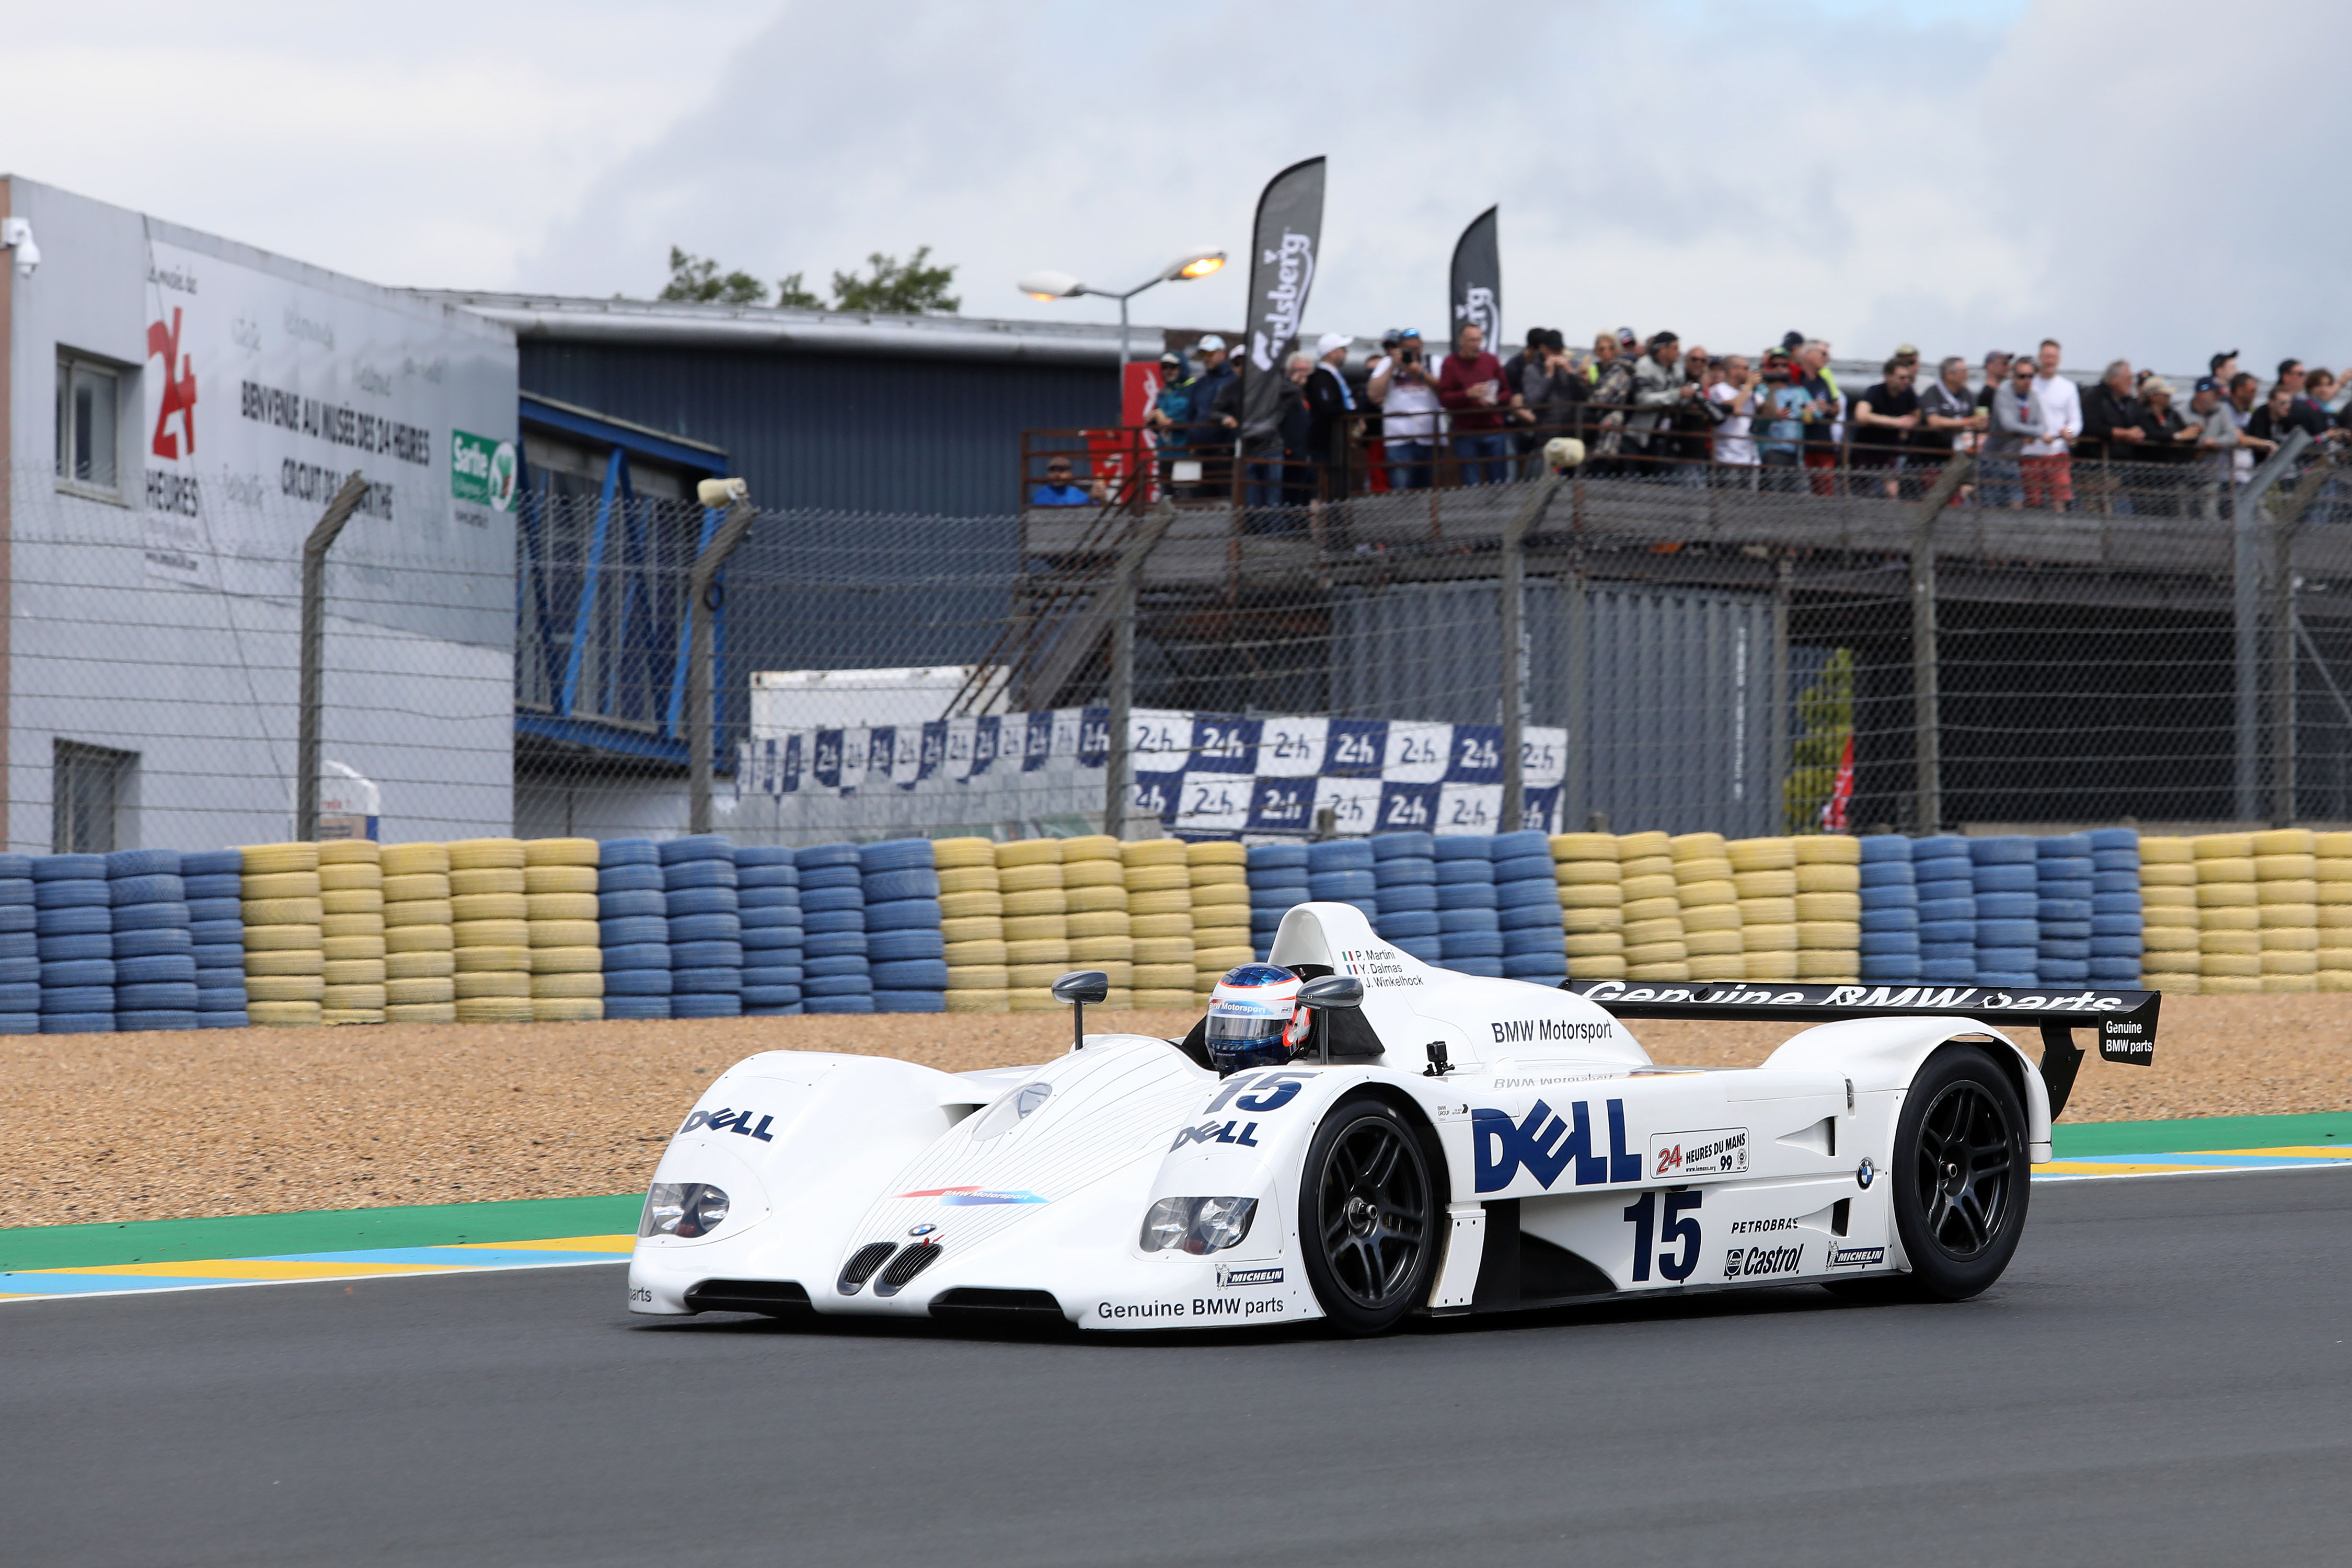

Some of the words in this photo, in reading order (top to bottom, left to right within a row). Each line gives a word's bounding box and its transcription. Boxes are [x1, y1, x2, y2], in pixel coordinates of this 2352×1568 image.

[1252, 234, 1314, 372] Carlsberg
[147, 306, 197, 460] 24
[242, 379, 298, 433] BIENVENUE
[302, 396, 320, 438] AU
[322, 401, 355, 448] MUSÉE
[358, 411, 375, 454] DES
[393, 420, 430, 467] HEURES
[146, 469, 197, 518] HEURES
[282, 456, 321, 503] CIRCUIT
[1136, 726, 1173, 751] 24h
[1202, 727, 1245, 758] 24h
[1274, 732, 1310, 759] 24h
[1334, 733, 1375, 764] 24h
[1400, 736, 1436, 764] 24h
[1460, 737, 1499, 769] 24h
[1522, 742, 1555, 769] 24h
[1134, 783, 1167, 815] 4h
[1192, 788, 1233, 815] 24h
[1261, 789, 1302, 820] 24h
[1386, 794, 1428, 824] 24h
[1452, 799, 1486, 824] 24h
[1355, 951, 1365, 961] P.
[1366, 949, 1396, 961] Martini
[1359, 964, 1369, 974] Y.
[1370, 963, 1402, 974] Dalmas
[1366, 977, 1374, 988] J.
[1373, 975, 1424, 987] Winkelhock
[1582, 981, 1804, 1005] Genuine
[1817, 986, 1978, 1008] BMW
[1221, 1002, 1266, 1013] Motorsport
[1491, 1020, 1534, 1043] BMW
[1540, 1019, 1612, 1043] Motorsport
[2106, 1020, 2142, 1034] Genuine
[2106, 1039, 2128, 1052] BMW
[2130, 1039, 2153, 1054] parts
[1203, 1072, 1321, 1115] 15
[679, 1108, 775, 1143] DELL
[1168, 1120, 1259, 1155] DELL
[1471, 1098, 1642, 1194] DELL
[1656, 1143, 1683, 1175] 24
[1686, 1144, 1712, 1165] HEURES
[1714, 1140, 1724, 1156] DU
[1725, 1133, 1746, 1151] MANS
[1720, 1155, 1733, 1171] 99
[971, 1191, 1030, 1200] Motorsport
[1624, 1190, 1703, 1282] 15
[1731, 1217, 1798, 1234] PETROBRAS
[1744, 1243, 1804, 1276] Castrol
[1838, 1250, 1883, 1262] MICHELIN
[1231, 1271, 1283, 1283] MICHELIN
[1098, 1300, 1185, 1319] Genuine
[1192, 1298, 1241, 1316] BMW
[1245, 1296, 1284, 1318] parts
